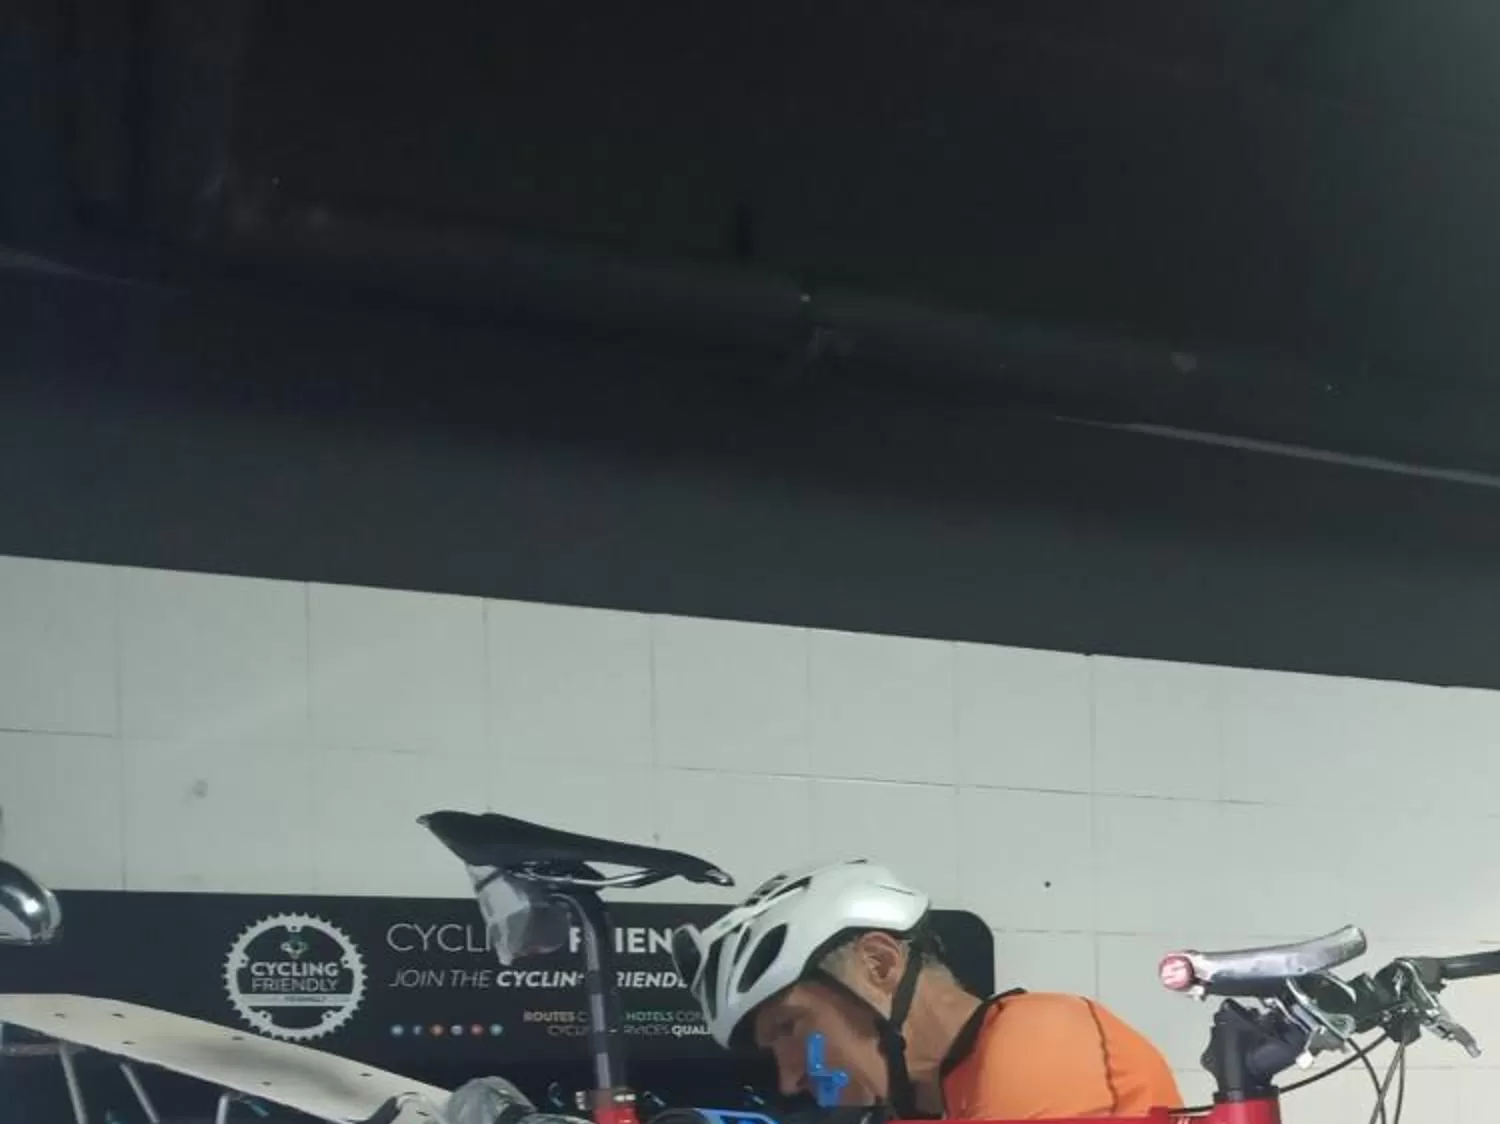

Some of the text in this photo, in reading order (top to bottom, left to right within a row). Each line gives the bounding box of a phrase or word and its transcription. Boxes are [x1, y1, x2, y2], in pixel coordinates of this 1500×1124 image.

[385, 923, 491, 953] CYCLI
[250, 961, 338, 977] CYCLING
[251, 978, 338, 992] FRIENDLY
[389, 969, 445, 988] JOIN
[449, 969, 494, 987] THE
[496, 971, 584, 988] CYCLIN
